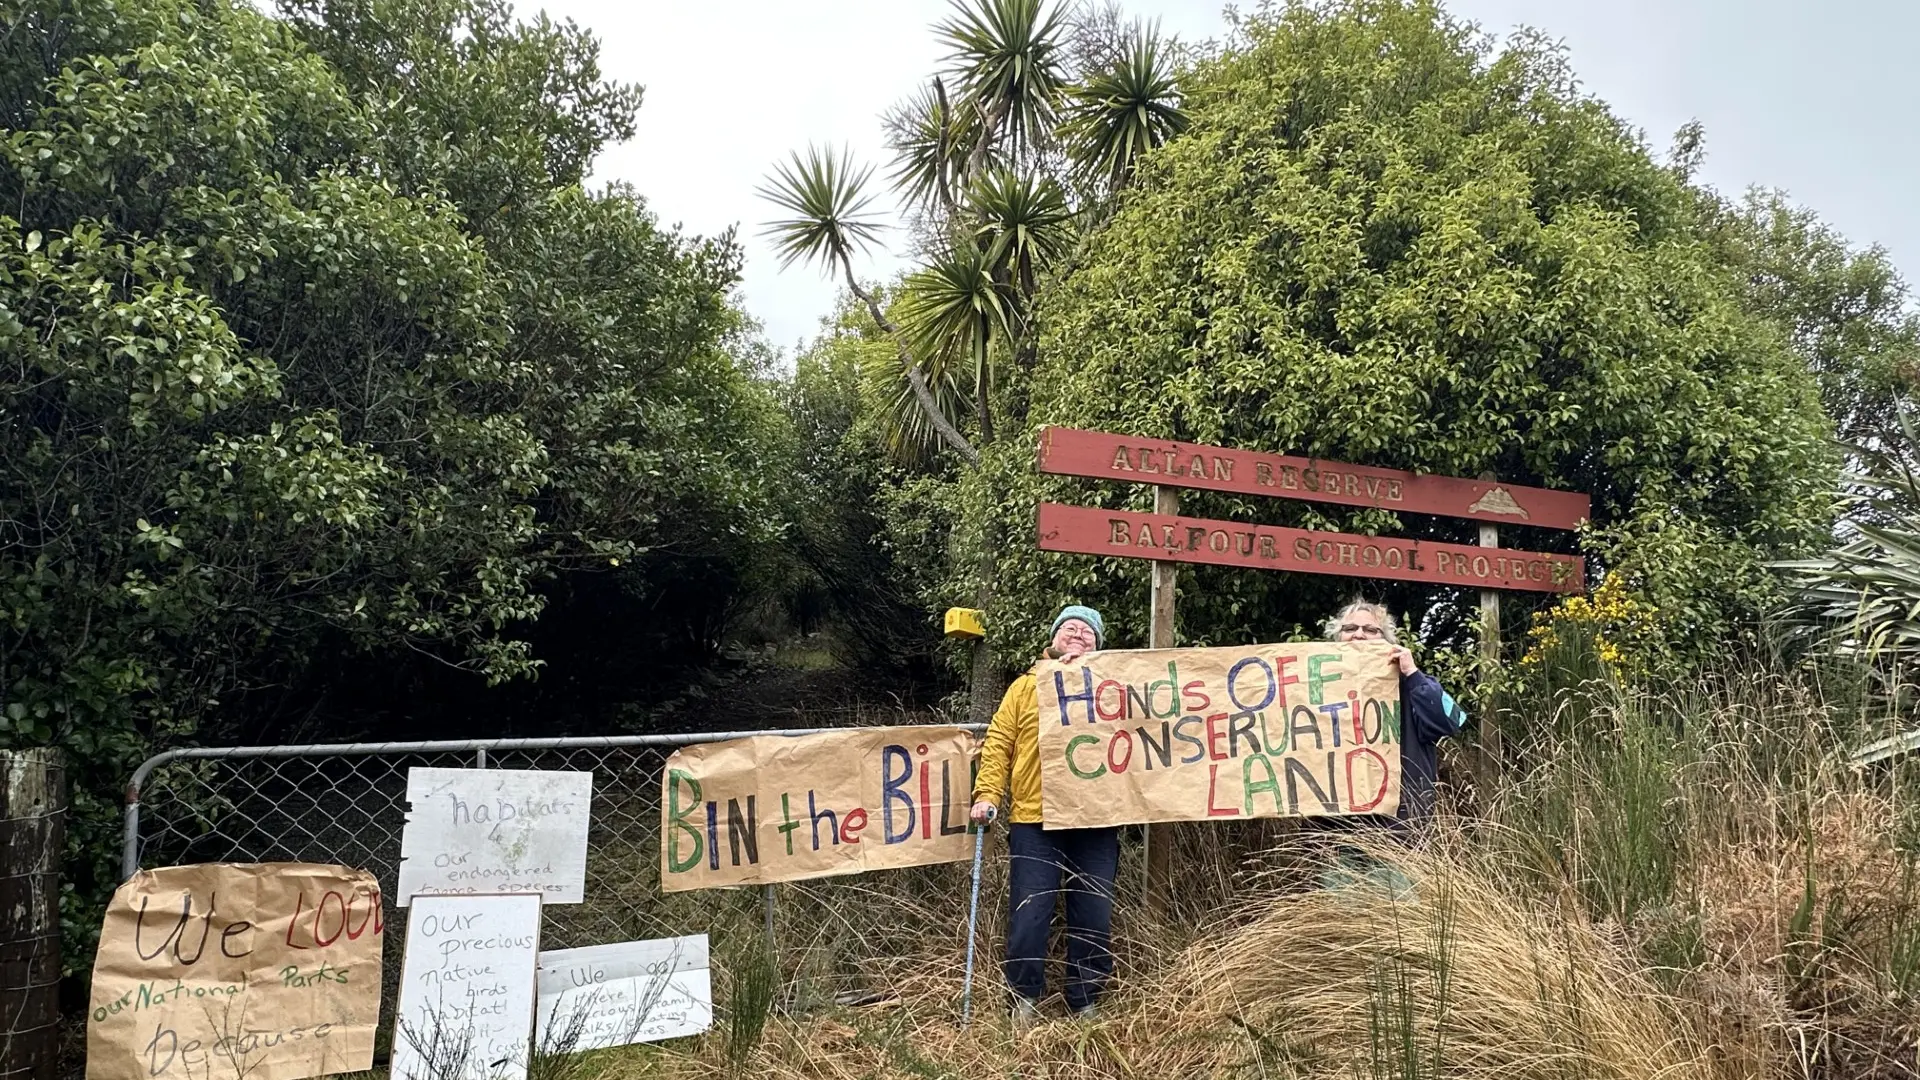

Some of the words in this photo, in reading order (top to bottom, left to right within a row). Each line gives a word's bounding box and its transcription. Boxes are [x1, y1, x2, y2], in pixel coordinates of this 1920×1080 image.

[1112, 445, 1235, 481] ALLAN
[1256, 462, 1404, 501] RESERVE
[1108, 519, 1280, 559] BALFOUR
[1294, 537, 1425, 570] SCHOOL
[1227, 654, 1342, 712] OFF
[1207, 747, 1388, 817] LAND
[668, 768, 759, 873] BIN
[778, 789, 868, 856] the
[448, 862, 553, 883] endangered
[136, 889, 254, 965] We
[438, 934, 533, 969] precious
[134, 971, 247, 1012] National
[279, 960, 350, 989] Parks
[420, 963, 496, 986] native
[466, 981, 509, 997] birds
[571, 965, 605, 987] We
